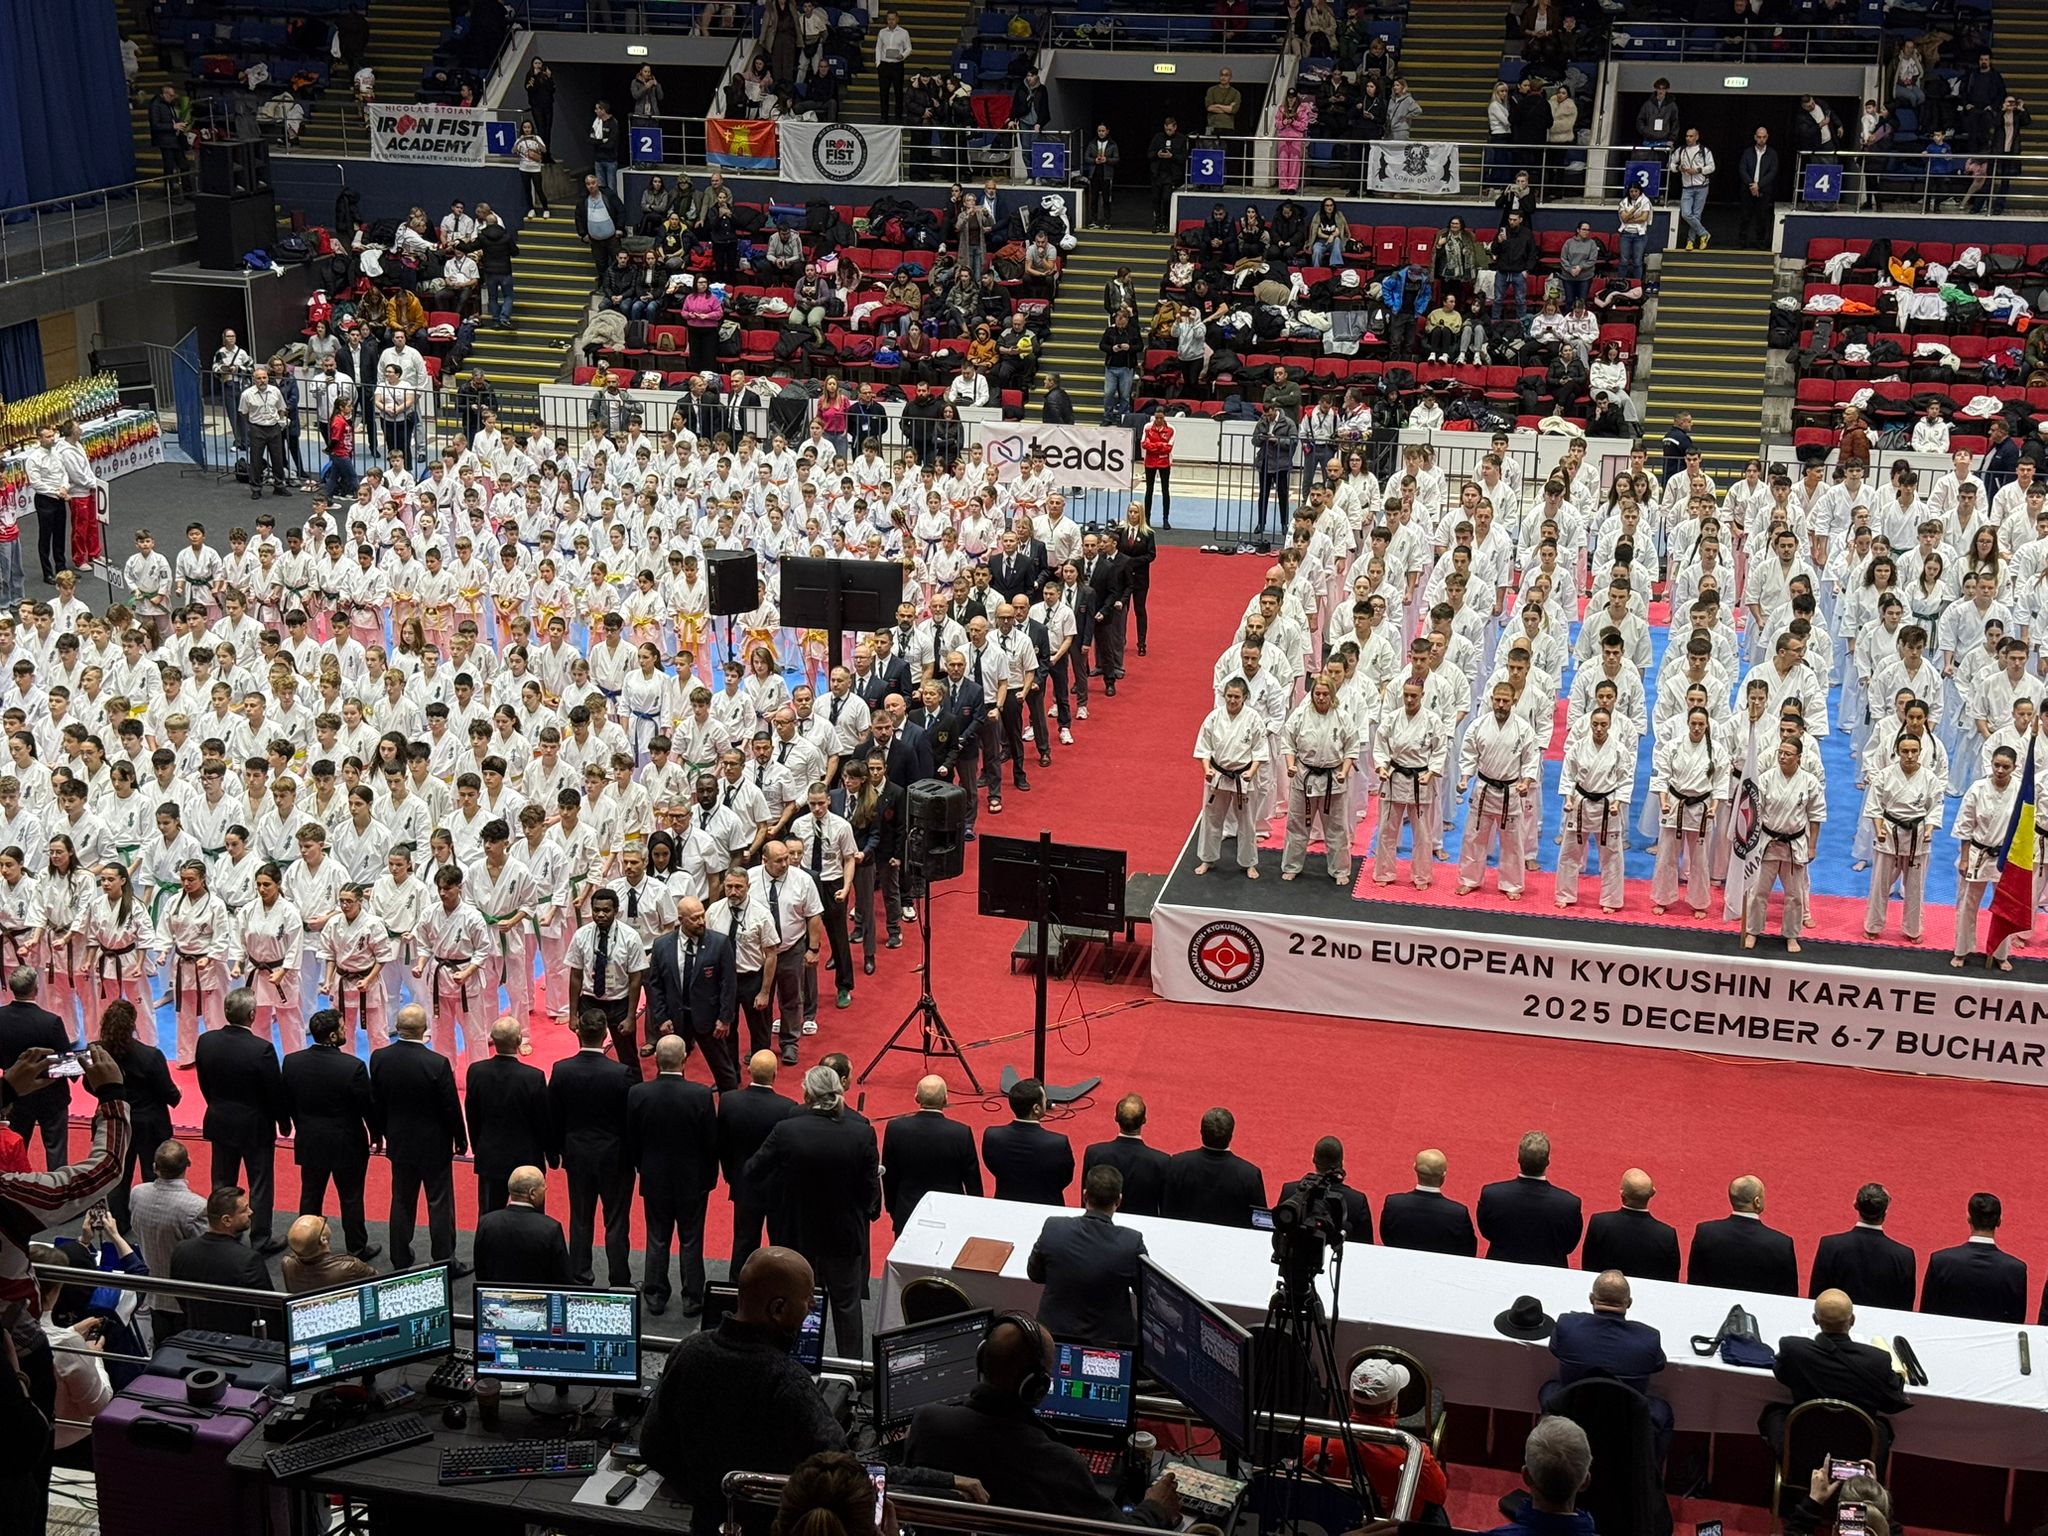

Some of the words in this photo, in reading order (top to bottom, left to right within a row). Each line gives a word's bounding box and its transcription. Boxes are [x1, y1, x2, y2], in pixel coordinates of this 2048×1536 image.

[385, 105, 430, 113] NICOLAE
[434, 106, 472, 115] STOIAN
[437, 117, 484, 137] FIST
[385, 137, 473, 154] ACADEMY
[495, 130, 505, 146] 1
[640, 136, 653, 153] 2
[825, 149, 854, 160] FIST
[1041, 152, 1055, 168] 2
[1201, 158, 1214, 176] 3
[1636, 170, 1649, 188] 3
[1815, 174, 1830, 193] 4
[97, 486, 107, 514] D
[1206, 923, 1248, 937] KYOKUSHIN
[1191, 933, 1209, 981] ORGANIZATION
[1238, 936, 1261, 986] INTERNATIONAL
[1288, 932, 1362, 960] 22ND
[1371, 940, 1554, 979] EUROPEAN
[1571, 959, 1771, 999] KYOKUSHIN
[1788, 979, 1937, 1015] KARATE
[1207, 979, 1238, 990] KARATE
[1523, 994, 1610, 1024] 2025
[1622, 1003, 1820, 1045] DECEMBER
[1831, 1025, 1886, 1051] 6-7
[1896, 1030, 2046, 1068] BUCHAR
